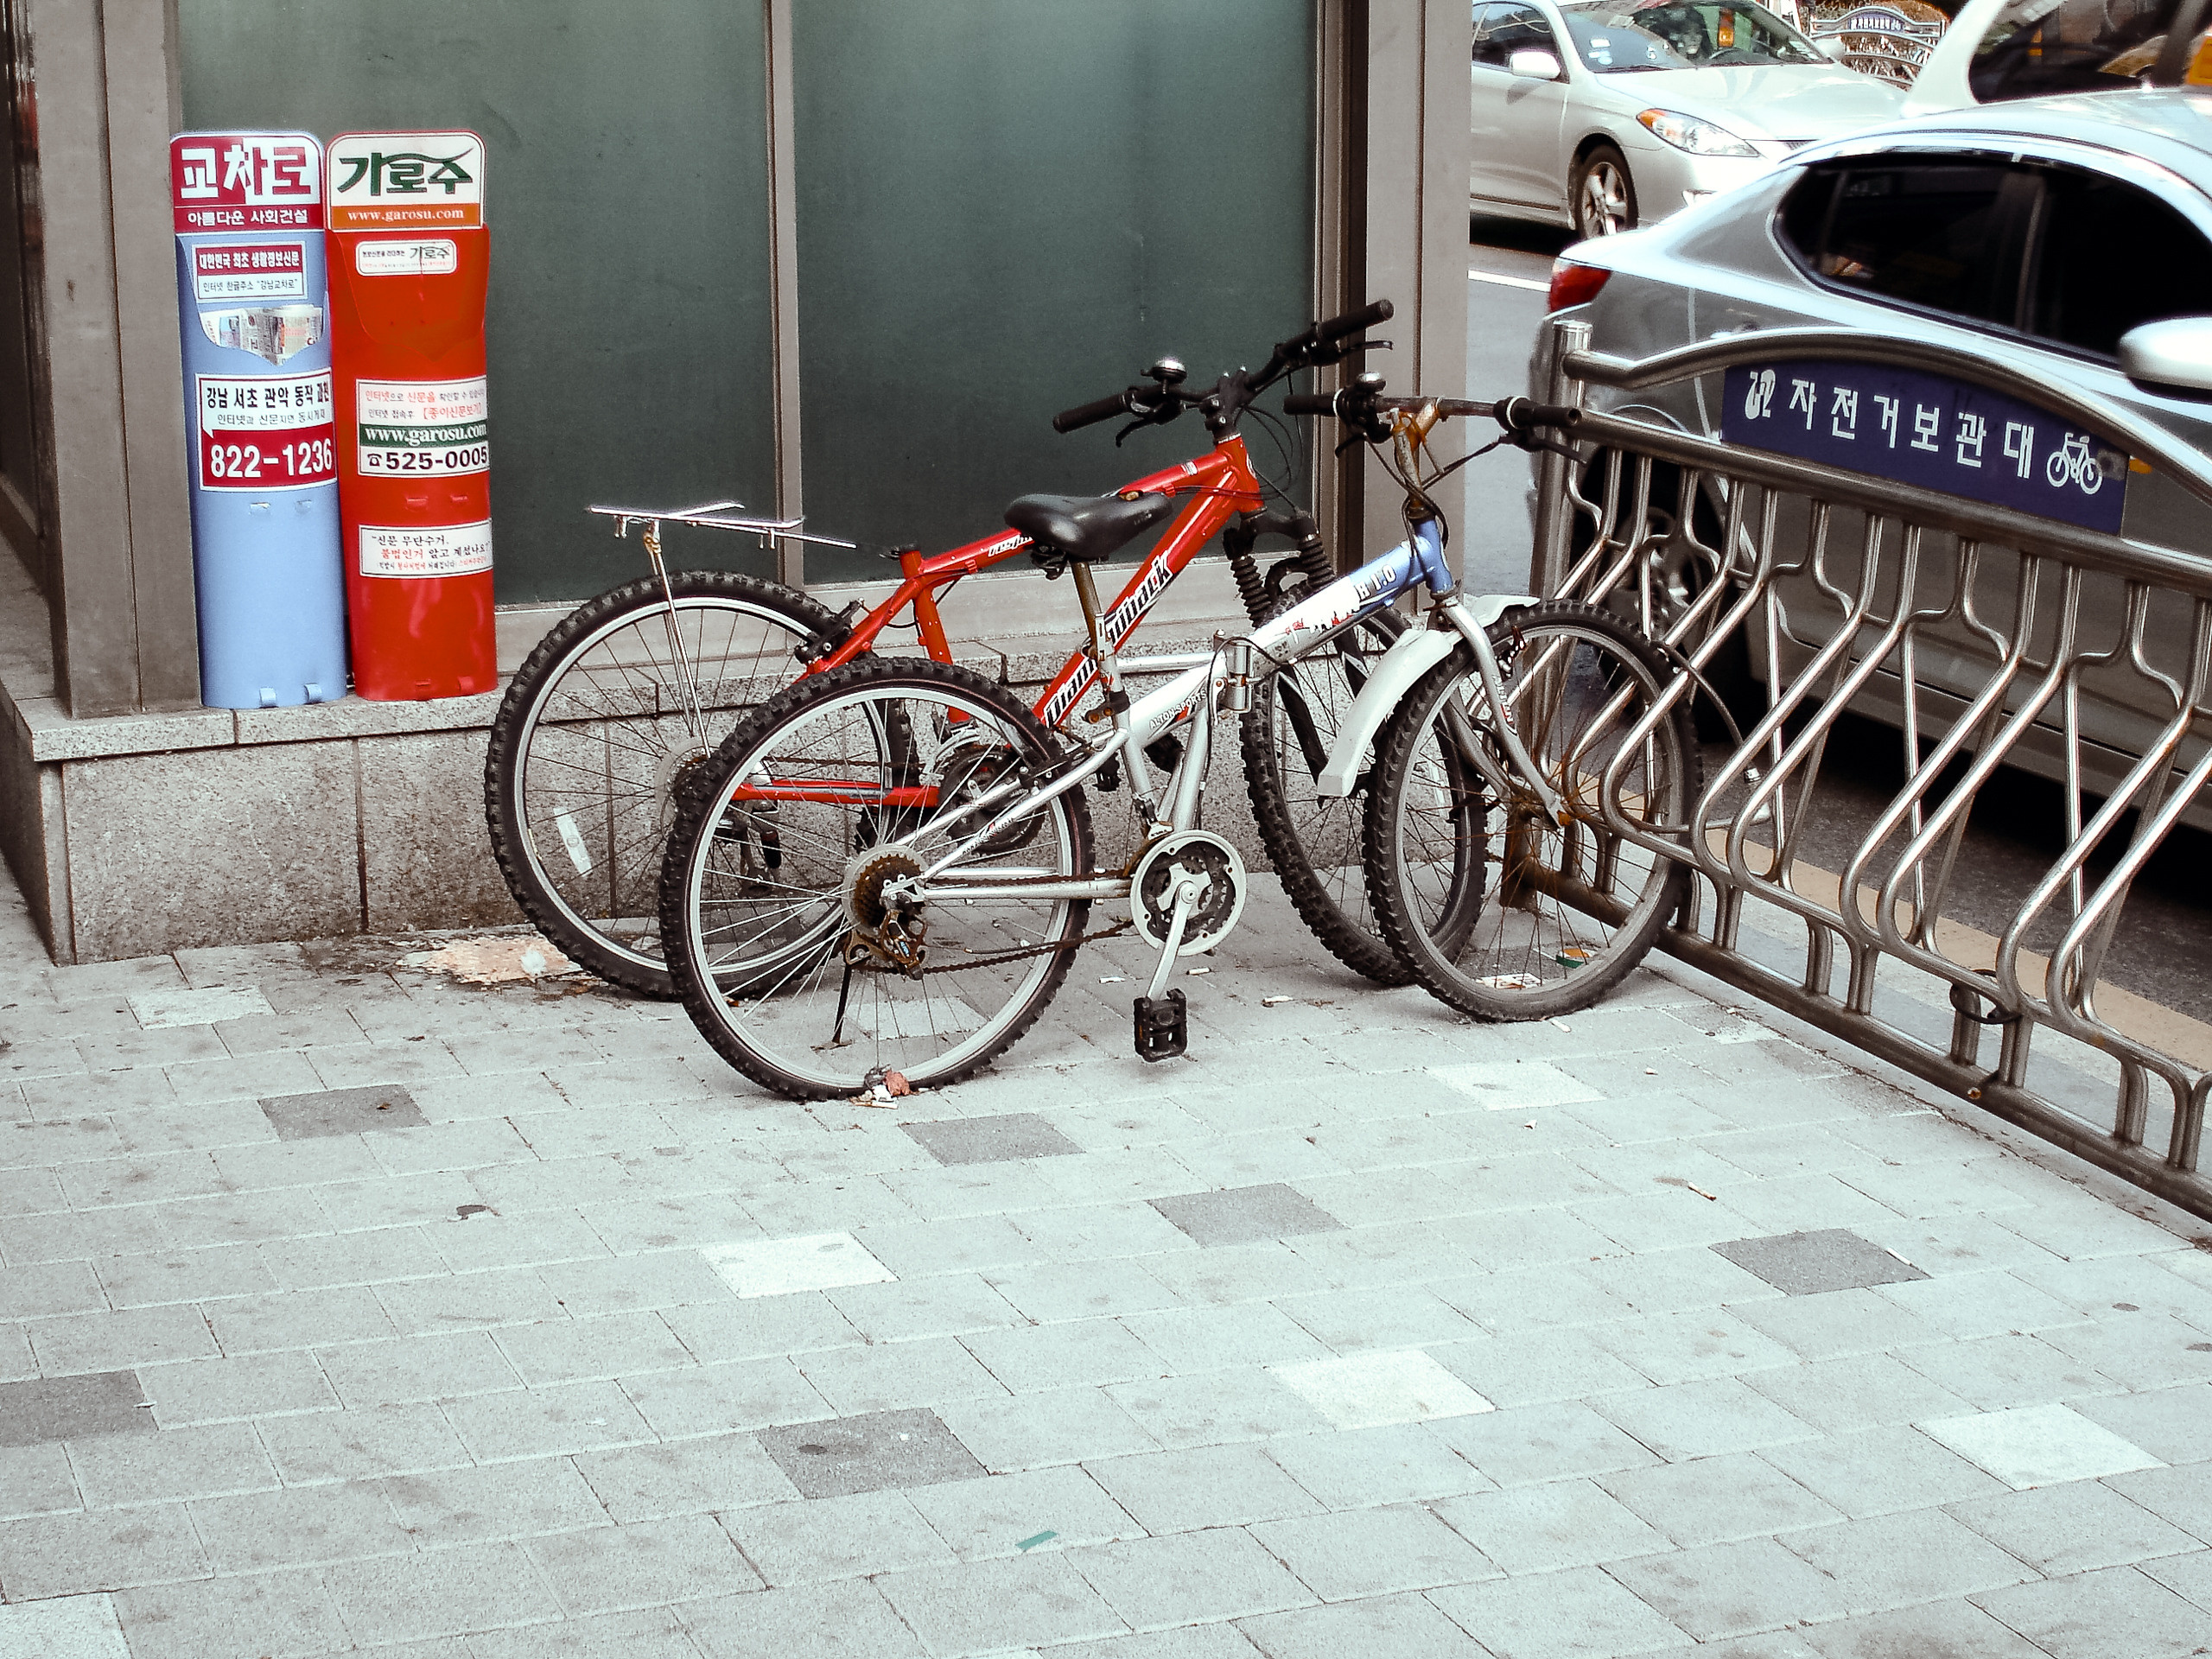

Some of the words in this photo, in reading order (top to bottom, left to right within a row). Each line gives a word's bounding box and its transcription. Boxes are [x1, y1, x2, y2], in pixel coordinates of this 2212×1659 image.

[181, 144, 312, 199] 교차로
[337, 146, 474, 197] 가로수
[188, 210, 245, 226] 아름다운
[250, 208, 308, 225] 사회건설
[347, 209, 464, 222] www.garosu.com
[198, 252, 231, 270] 대한민국
[232, 251, 250, 268] 최초
[251, 251, 300, 268] 생활정보신문
[410, 245, 450, 259] 가로수
[203, 282, 224, 292] 인터넷
[226, 281, 253, 291] 한글주소
[207, 387, 228, 409] 강남
[233, 387, 258, 409] 서초
[264, 386, 289, 408] 관악
[295, 385, 314, 407] 동작
[316, 380, 329, 403] 과천
[365, 390, 404, 402] 인터넷으로
[408, 391, 435, 403] 신문을
[217, 413, 254, 425] 인터넷과
[368, 409, 389, 418] 인터넷
[365, 423, 487, 447] www.garosu.com
[1789, 378, 2035, 480] 자전거보관대
[210, 437, 333, 478] 822-1236
[386, 446, 488, 470] 525-0005
[1149, 689, 1207, 729] ALTON-SPORTS
